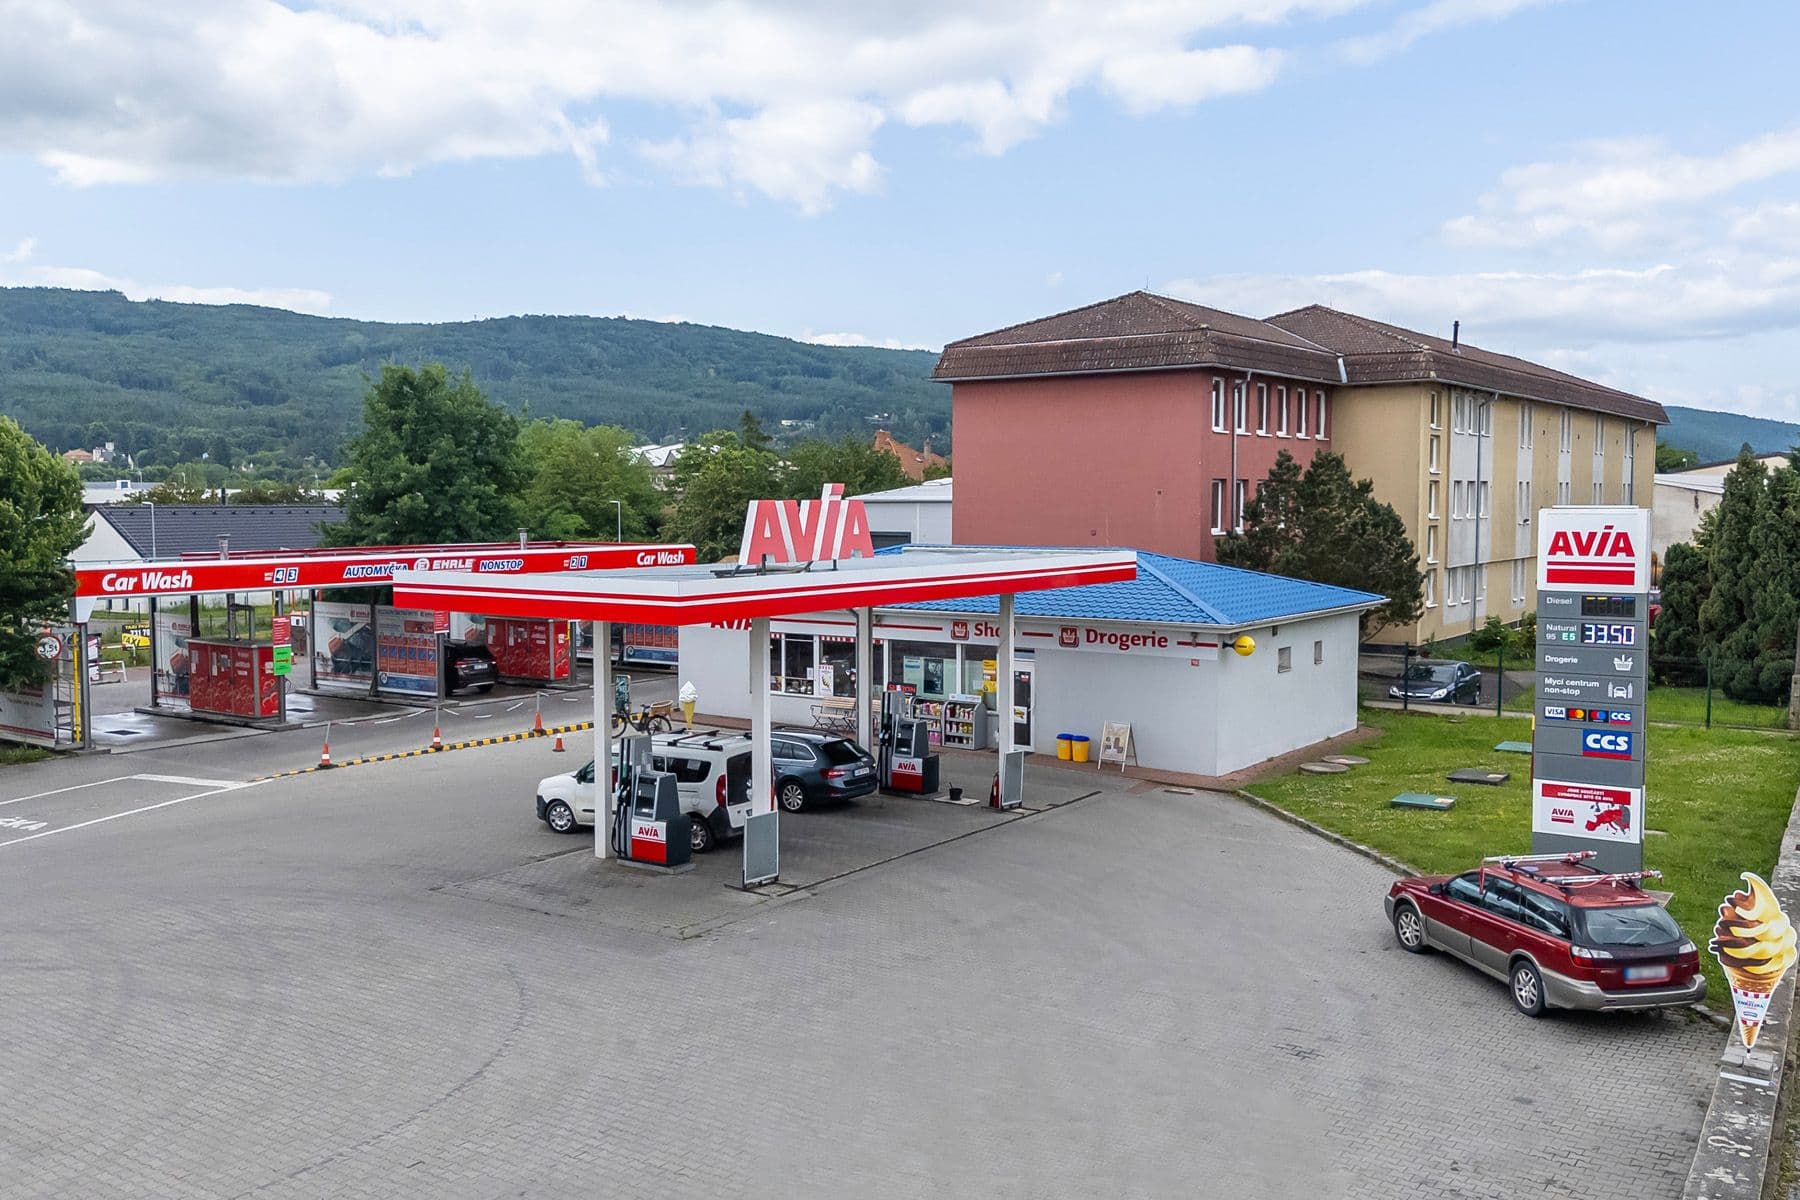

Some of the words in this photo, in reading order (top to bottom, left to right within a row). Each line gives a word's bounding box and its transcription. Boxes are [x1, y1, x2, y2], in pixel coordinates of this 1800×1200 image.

[636, 552, 656, 566] Car
[657, 549, 685, 564] Wash
[432, 559, 473, 570] EHRLE
[480, 559, 523, 572] NONSTOP
[101, 573, 138, 592] Car
[142, 569, 193, 590] Wash
[1546, 596, 1573, 605] Diesel
[1546, 623, 1577, 632] Natural
[1085, 628, 1169, 651] Drogerie
[1546, 632, 1556, 640] 95
[1562, 632, 1576, 641] E5
[1583, 624, 1635, 645] 33.50
[1544, 654, 1579, 664] Drogerie
[1544, 677, 1564, 686] Mycí
[1565, 679, 1600, 688] centrum
[1544, 687, 1580, 697] non-stop
[1547, 707, 1564, 716] VISA
[1611, 712, 1631, 721] CCS
[1585, 733, 1629, 751] CCS
